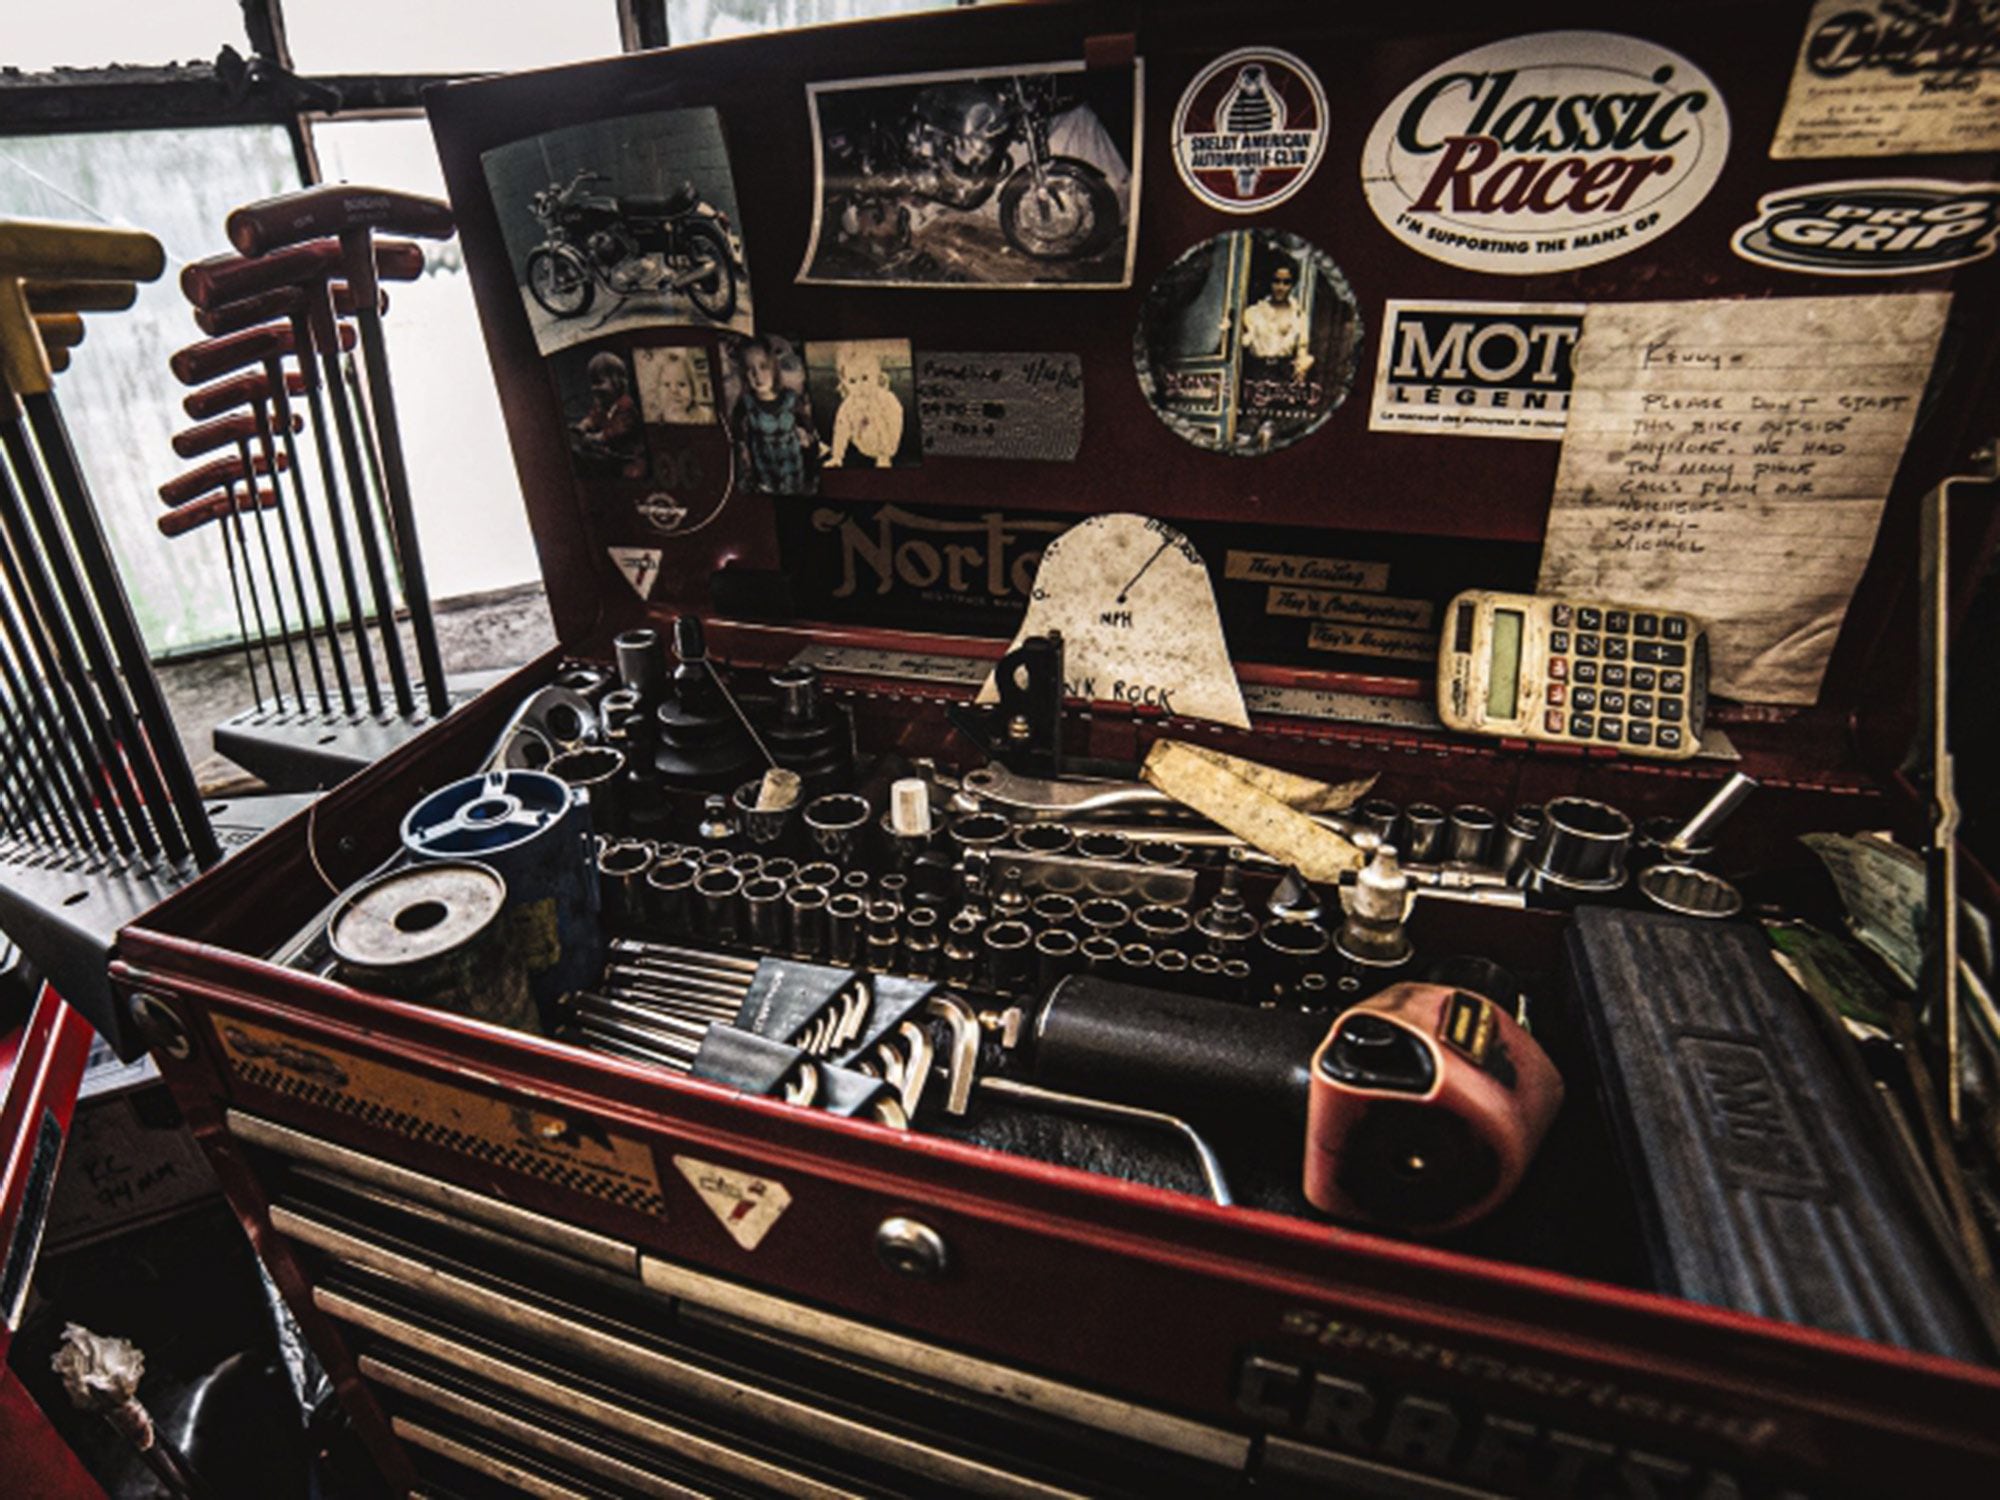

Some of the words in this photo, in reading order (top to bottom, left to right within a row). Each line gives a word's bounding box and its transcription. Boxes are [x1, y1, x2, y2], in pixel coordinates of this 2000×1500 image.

[1396, 64, 1709, 155] Classic
[1191, 135, 1239, 150] SHELBY
[1241, 133, 1312, 148] AMERICAN
[1191, 151, 1271, 167] AUTOMOBILE
[1274, 150, 1308, 165] CLUB
[1407, 136, 1674, 215] Racer
[1825, 201, 1990, 224] PRO
[1396, 213, 1424, 234] I'M
[1426, 227, 1530, 254] SUPPORTING
[1536, 239, 1567, 253] THE
[1572, 225, 1629, 249] MANX
[1634, 212, 1661, 232] GP
[1771, 218, 1987, 250] GRIP
[1393, 321, 1578, 382] MOT
[1641, 394, 1724, 412] PLEASE
[1838, 395, 1911, 412] START
[1691, 420, 1743, 436] BIKE
[1758, 416, 1852, 437] OUTSIDE
[1752, 440, 1786, 454] WE
[1802, 442, 1846, 456] HAD
[1677, 462, 1735, 484] MANY
[1752, 461, 1816, 480] PHONE
[1773, 481, 1815, 494] OUR
[811, 502, 1072, 598] Norto
[1299, 560, 1366, 588] Exciting
[1101, 610, 1133, 628] MPH
[1112, 679, 1178, 716] ROCK
